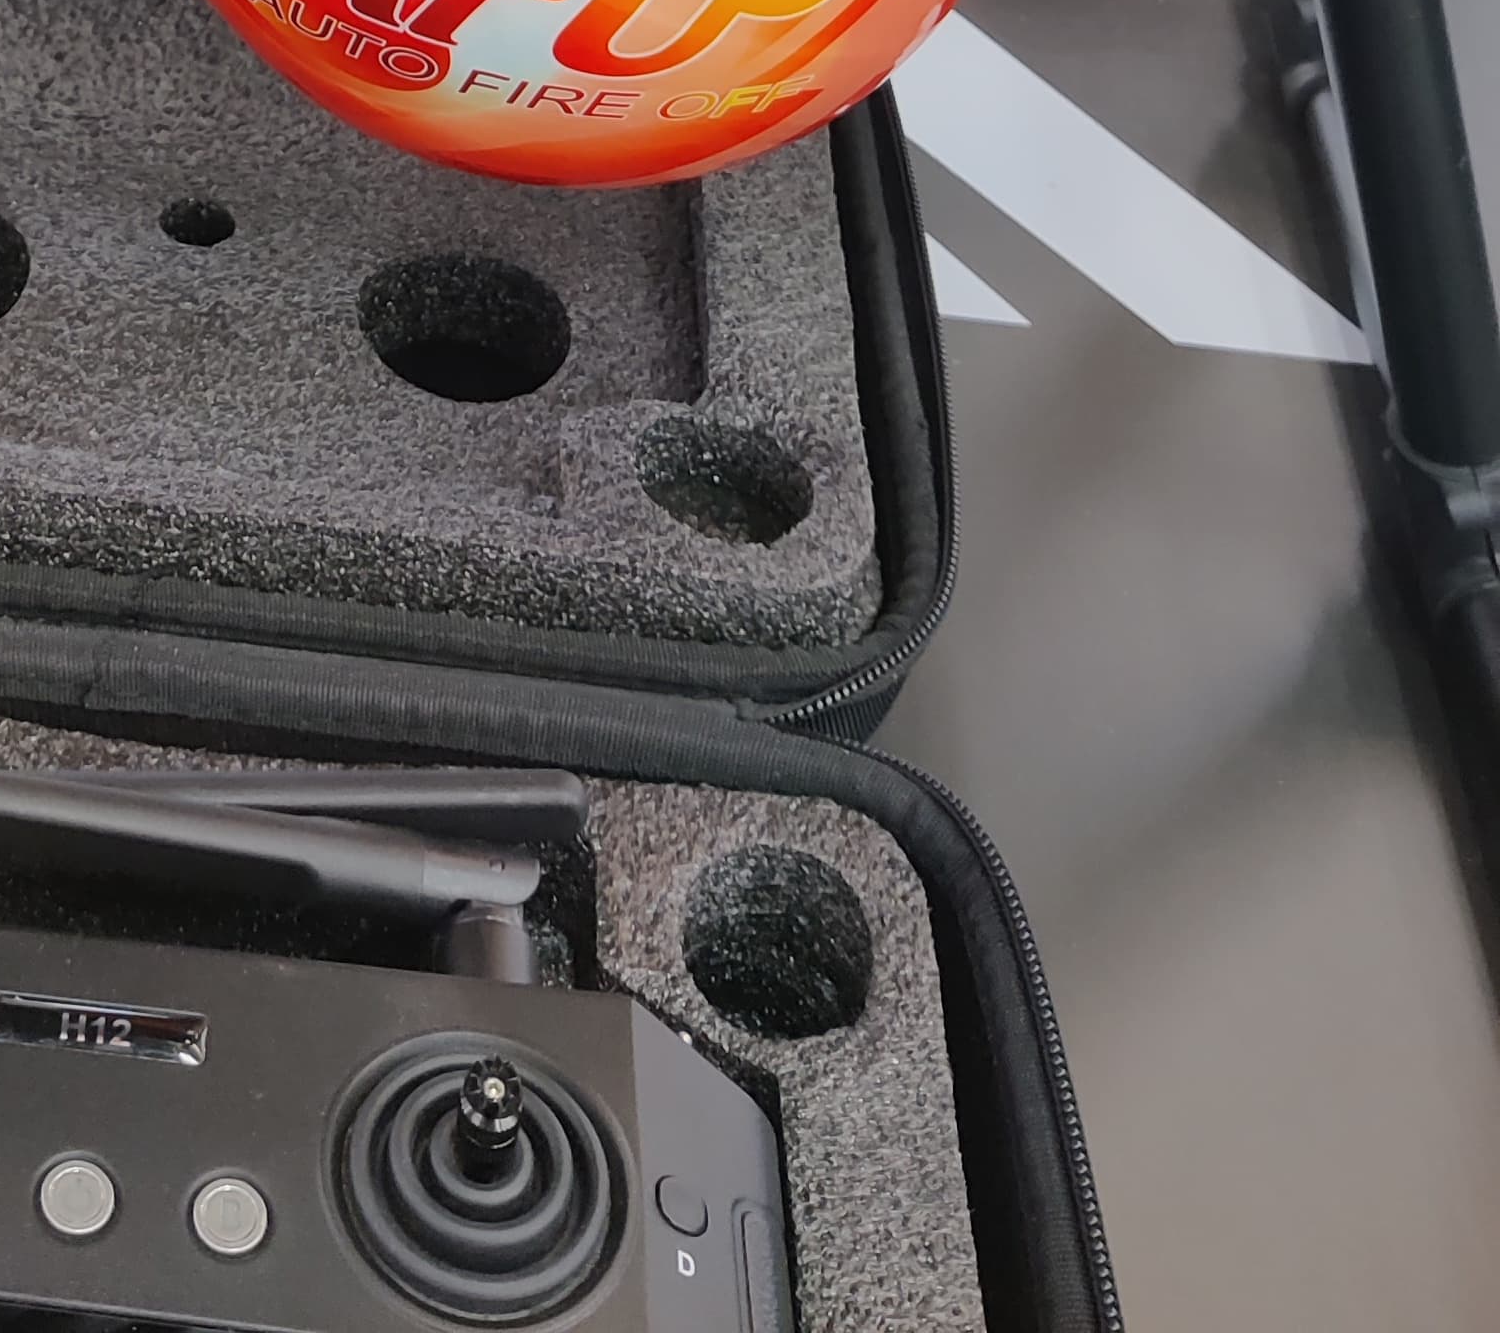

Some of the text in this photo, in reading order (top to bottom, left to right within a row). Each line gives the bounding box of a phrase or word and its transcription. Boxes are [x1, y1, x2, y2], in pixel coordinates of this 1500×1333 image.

[457, 69, 641, 123] FIRE
[659, 73, 813, 121] OFF
[59, 1012, 132, 1047] H12
[677, 1249, 696, 1277] D
